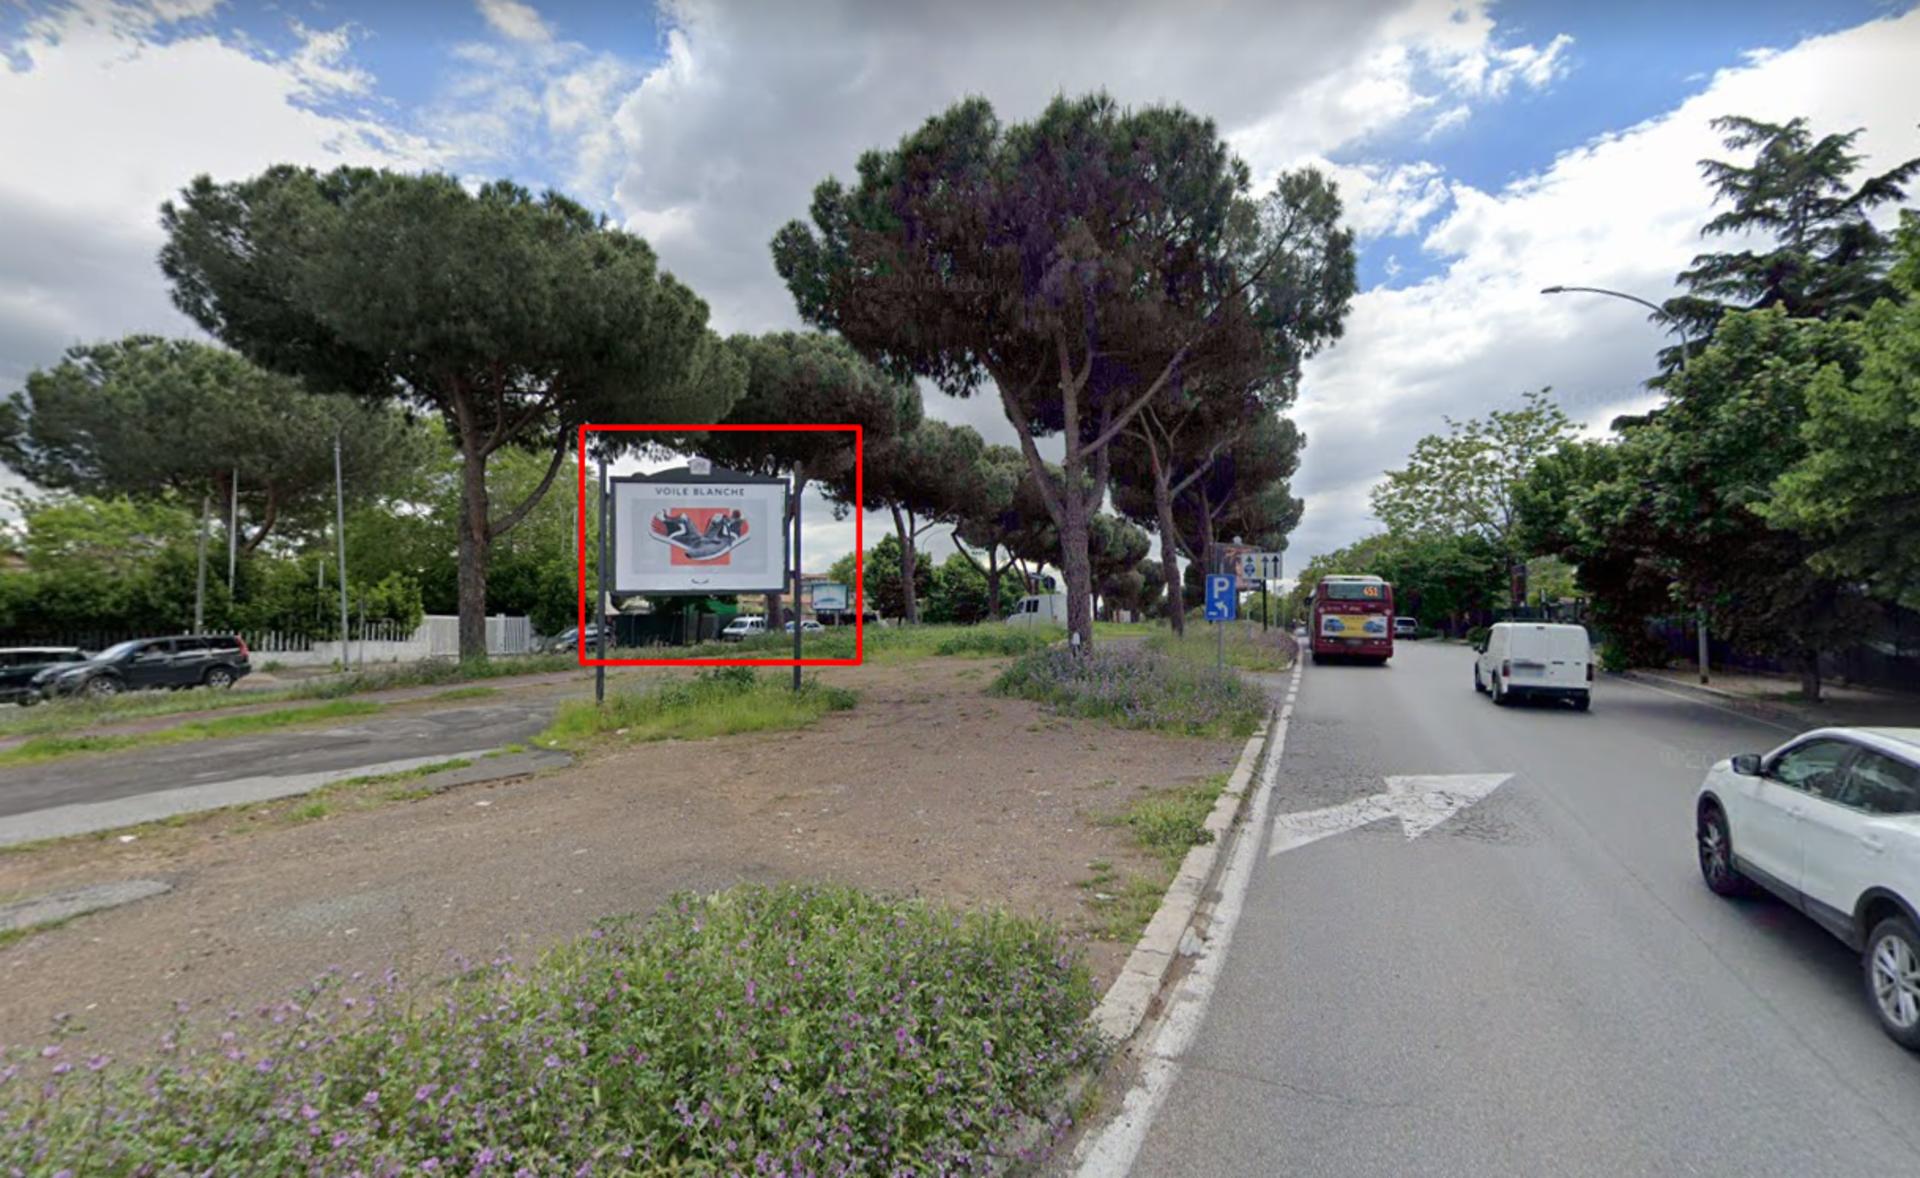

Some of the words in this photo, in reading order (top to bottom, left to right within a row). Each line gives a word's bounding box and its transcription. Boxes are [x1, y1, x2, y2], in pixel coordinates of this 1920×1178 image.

[655, 487, 688, 496] VOILE
[693, 487, 744, 496] BLANCHE
[1214, 577, 1229, 599] P
